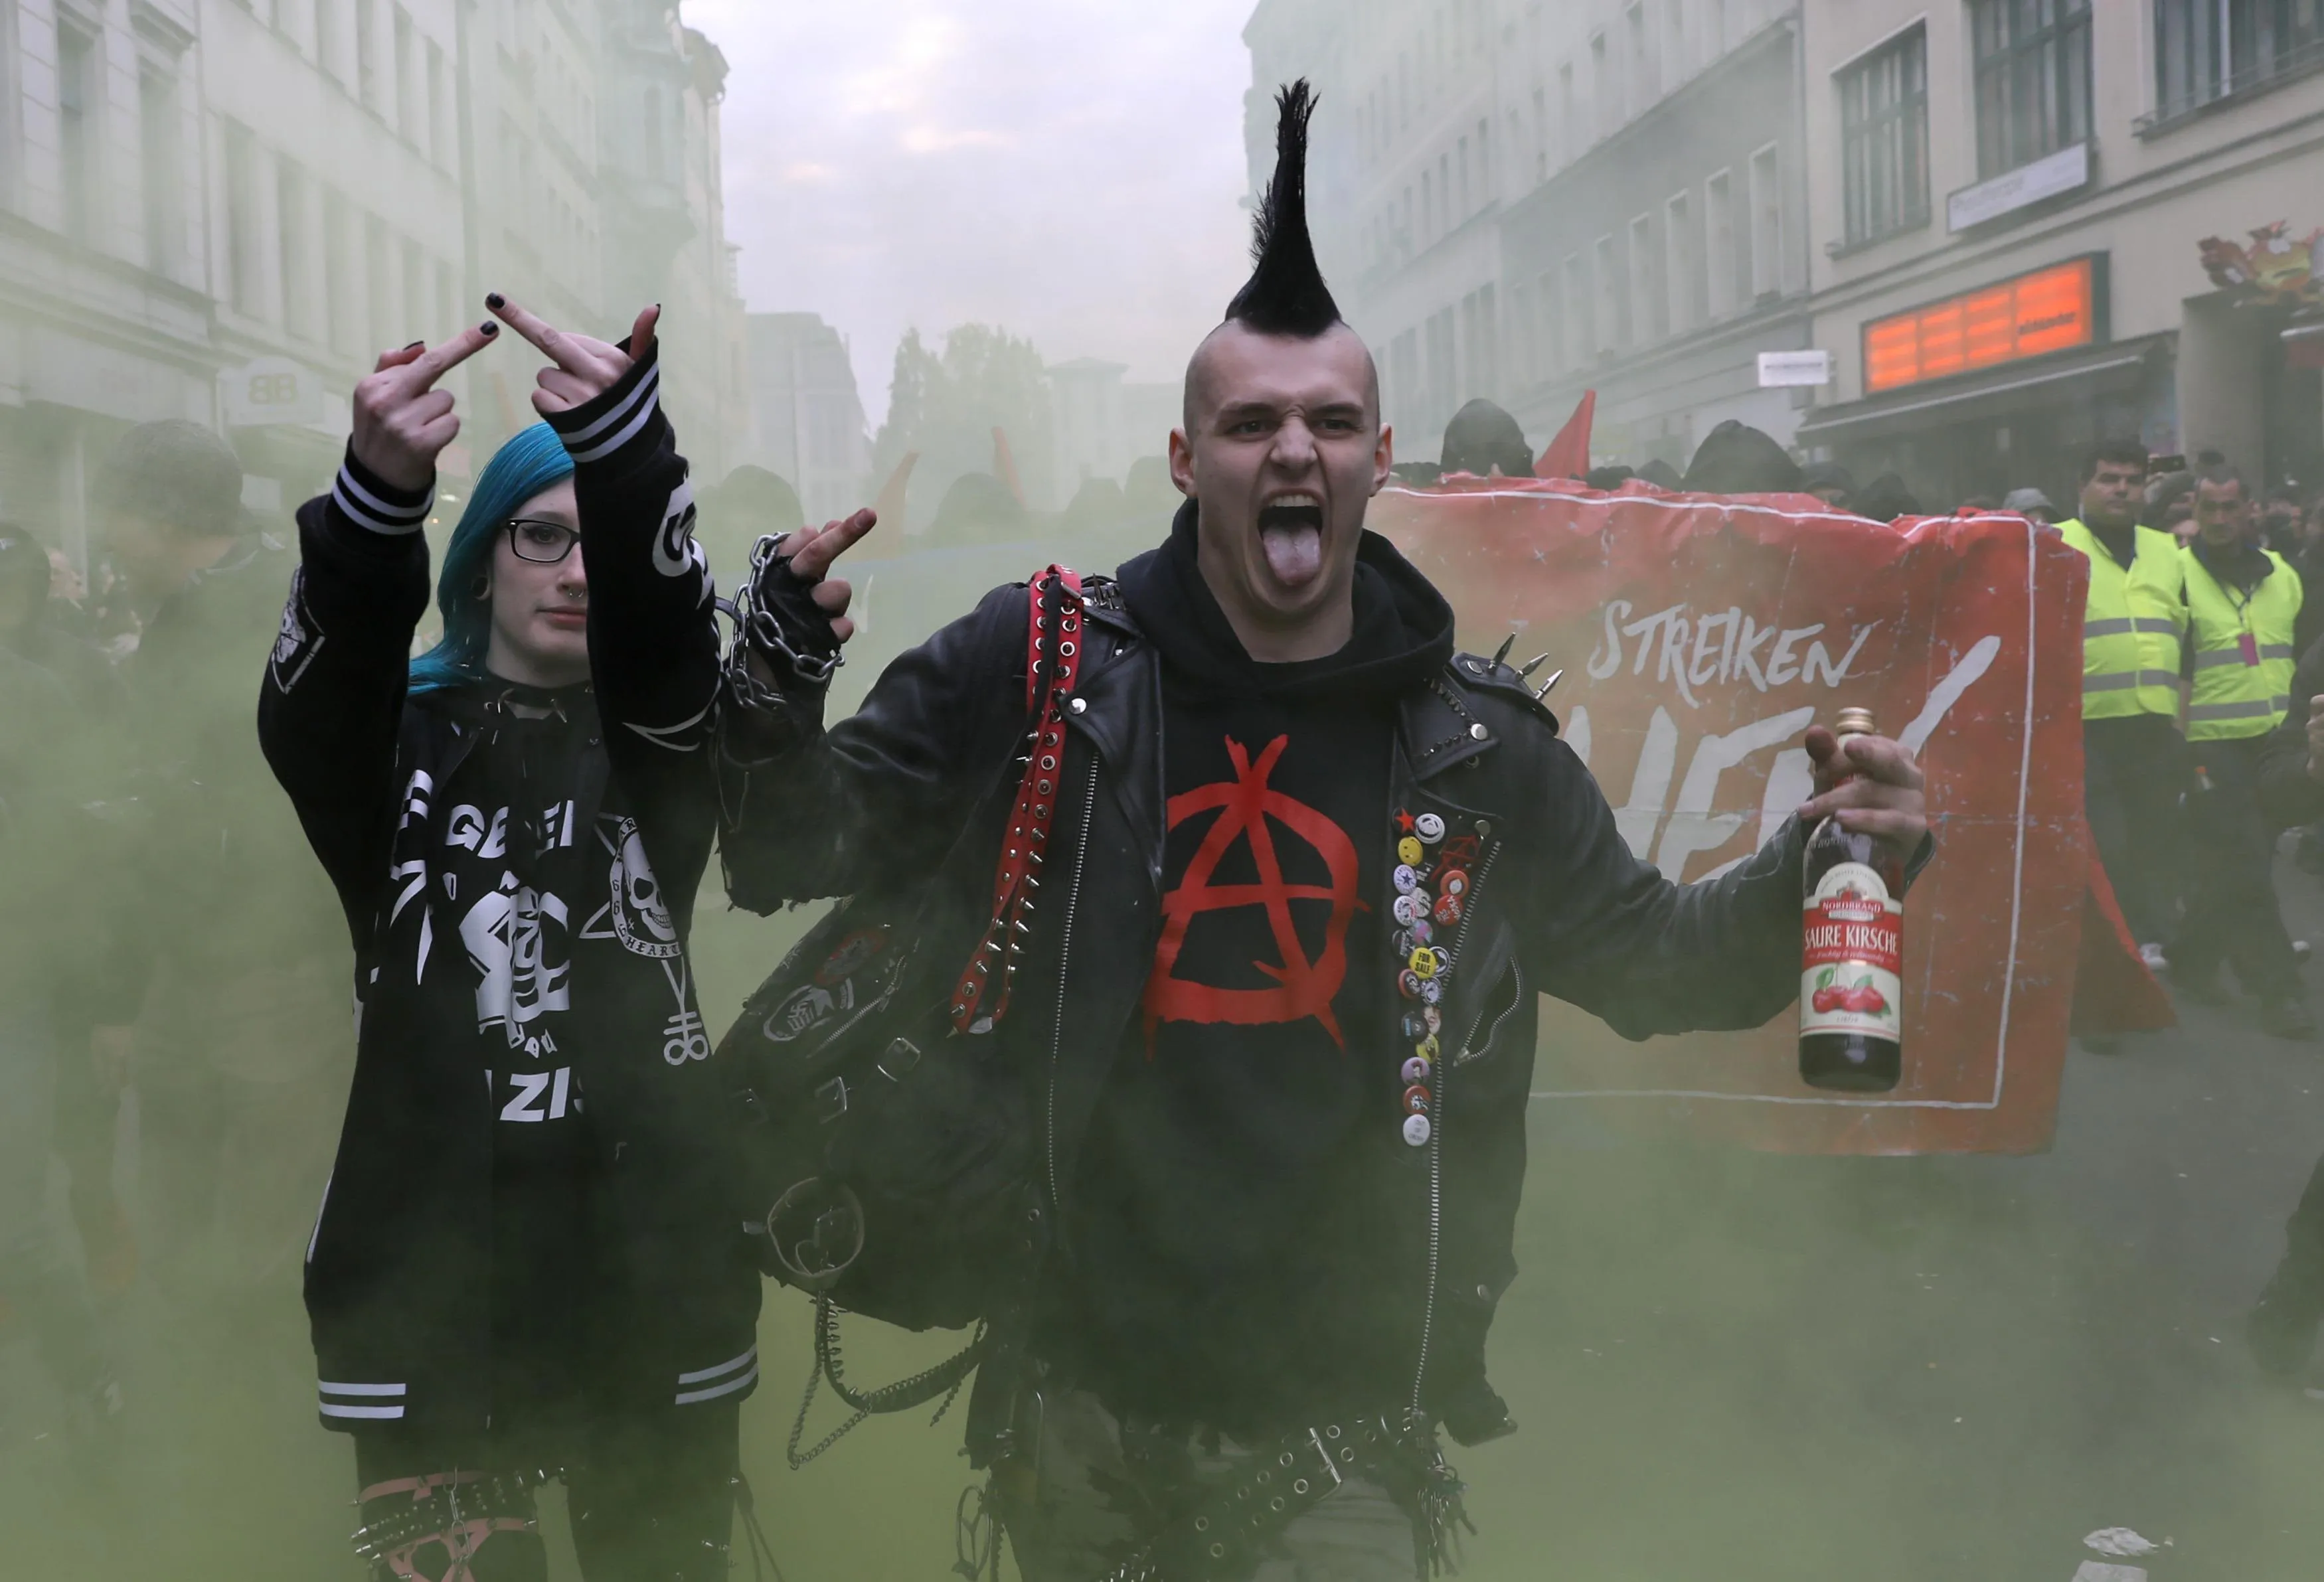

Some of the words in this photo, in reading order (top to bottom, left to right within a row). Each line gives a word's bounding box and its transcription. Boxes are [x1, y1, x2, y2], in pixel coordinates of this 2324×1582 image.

[1587, 599, 1875, 709] STREIKEN
[1805, 924, 1842, 951] SAURE
[1845, 925, 1898, 956] KIRSCHE
[1415, 961, 1431, 974] SALE
[1418, 951, 1431, 963] FOR
